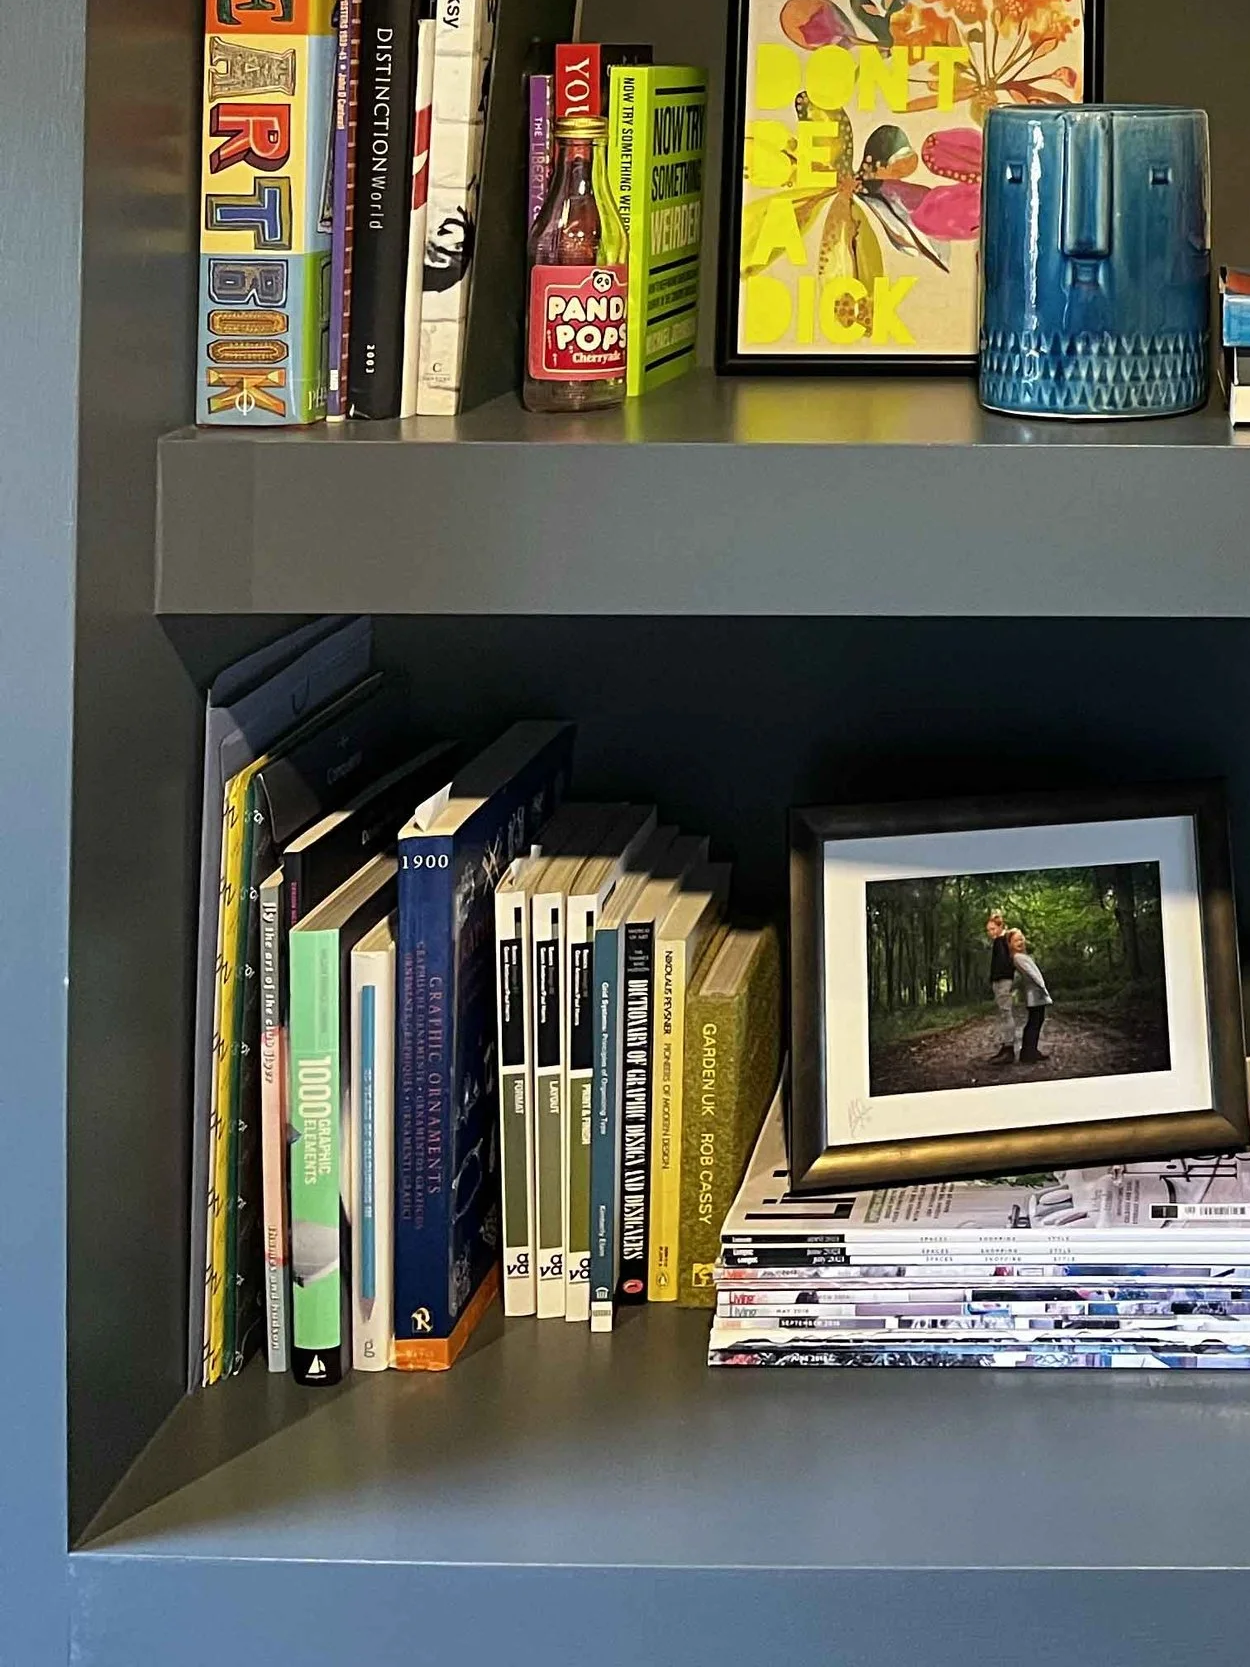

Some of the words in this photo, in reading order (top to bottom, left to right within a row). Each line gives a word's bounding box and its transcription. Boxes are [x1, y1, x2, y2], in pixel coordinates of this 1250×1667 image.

[622, 77, 635, 103] NOW
[533, 116, 543, 137] THE
[621, 105, 634, 126] TRY
[653, 105, 684, 157] NOW
[205, 35, 296, 252] ART
[619, 128, 634, 192] SOMETHING
[747, 120, 841, 189] BE
[531, 142, 546, 201] LIBERTY
[651, 159, 702, 203] SOMETH
[619, 195, 632, 231] WEIR
[752, 197, 807, 265] A
[547, 295, 627, 323] PAND
[745, 276, 919, 346] DICK
[206, 259, 289, 419] BOOK
[555, 323, 627, 352] POPS
[400, 852, 450, 872] 1900
[264, 927, 276, 950] the
[264, 952, 275, 972] art
[664, 950, 673, 995] NIKOLAUS
[262, 974, 276, 992] of
[264, 994, 275, 1016] the
[427, 976, 443, 1062] GRAPHIC
[625, 979, 649, 1048] DICTIONARY
[663, 996, 673, 1035] PEVSNER
[626, 1050, 649, 1067] OF
[702, 1023, 717, 1090] GARDEN
[513, 1080, 525, 1114] FORMAT
[549, 1080, 560, 1114] LAYOUT
[625, 1069, 648, 1122] GRAPHIC
[662, 1084, 671, 1095] OF
[701, 1093, 715, 1116] UK
[297, 1055, 332, 1118] 1000
[318, 1118, 332, 1173] GRAPHIC
[426, 1073, 443, 1195] ORNAMENTS
[303, 1118, 318, 1185] ELEMENTS
[624, 1124, 647, 1166] DESIGN
[661, 1138, 671, 1169] DESIGN
[700, 1133, 714, 1166] ROB
[624, 1168, 646, 1192] AND
[698, 1170, 712, 1225] CASSY
[622, 1194, 646, 1261] DESIGNERS
